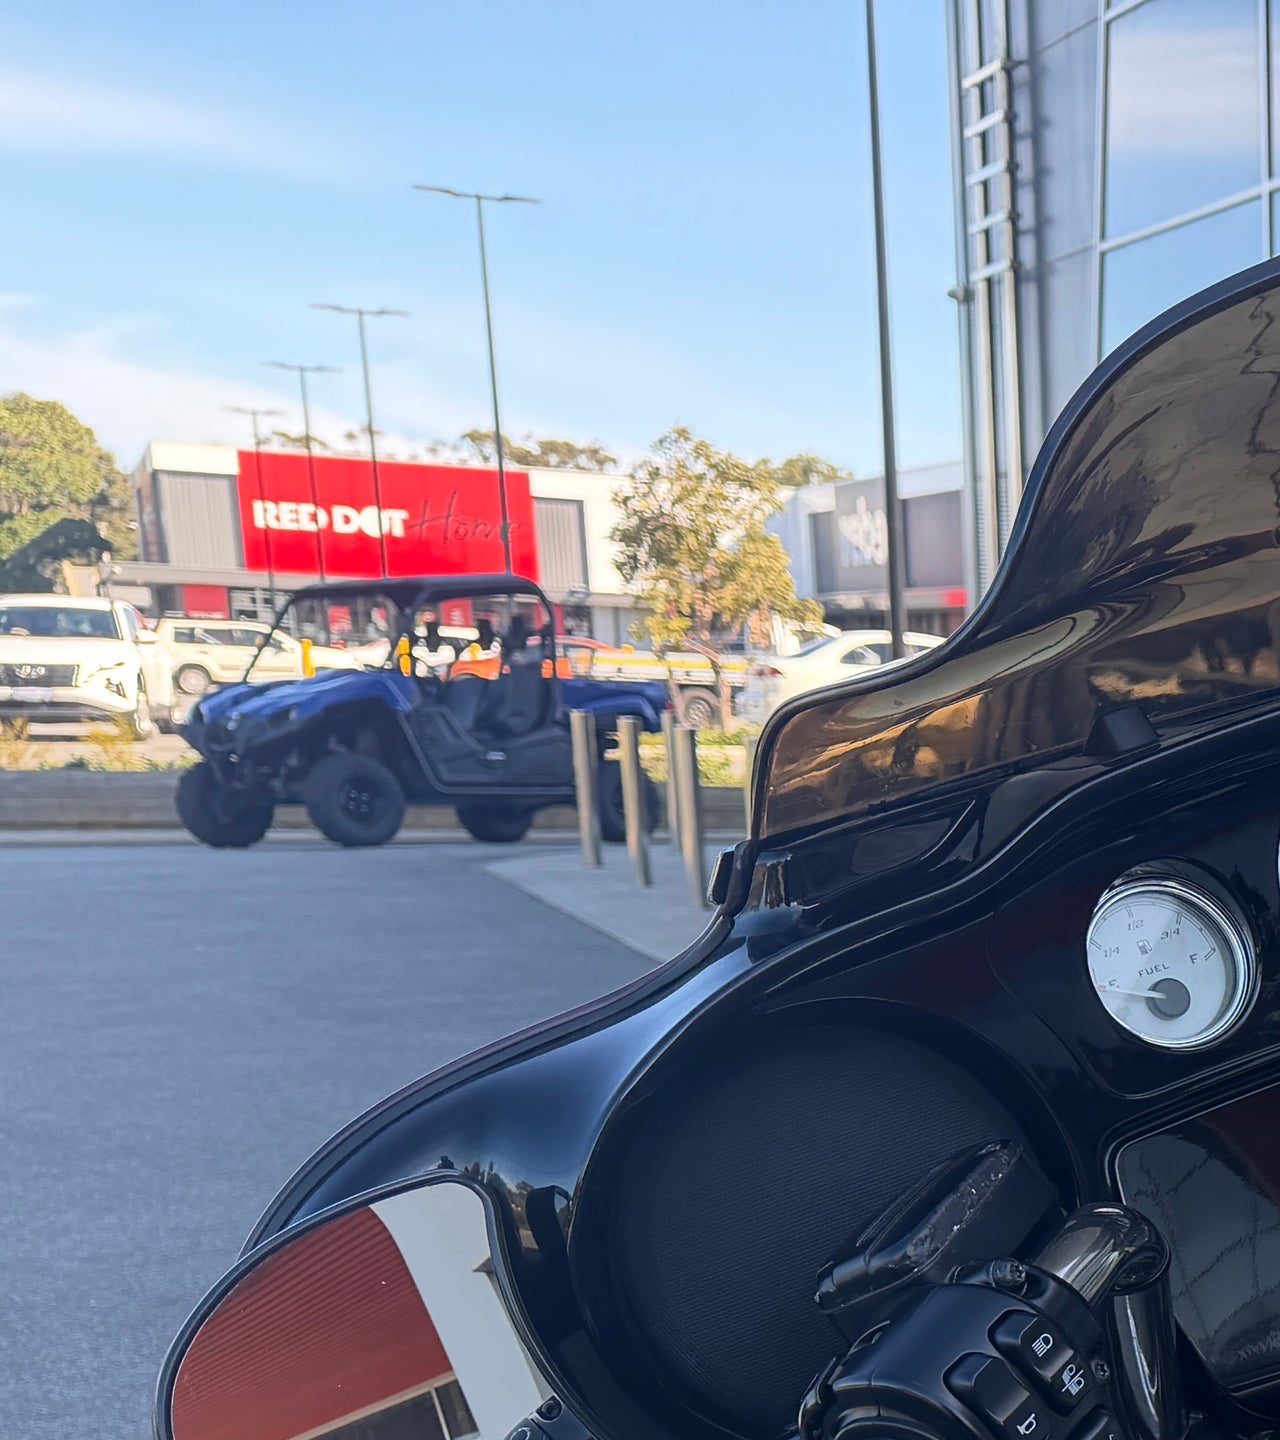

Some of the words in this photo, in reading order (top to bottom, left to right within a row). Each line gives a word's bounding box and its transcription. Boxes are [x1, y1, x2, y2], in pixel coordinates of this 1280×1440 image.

[252, 499, 329, 532] RED
[1127, 920, 1145, 931] 1/2
[1160, 928, 1181, 940] 3/4
[1103, 946, 1120, 958] 1/4
[1189, 953, 1198, 965] F
[1138, 963, 1170, 978] FUEL
